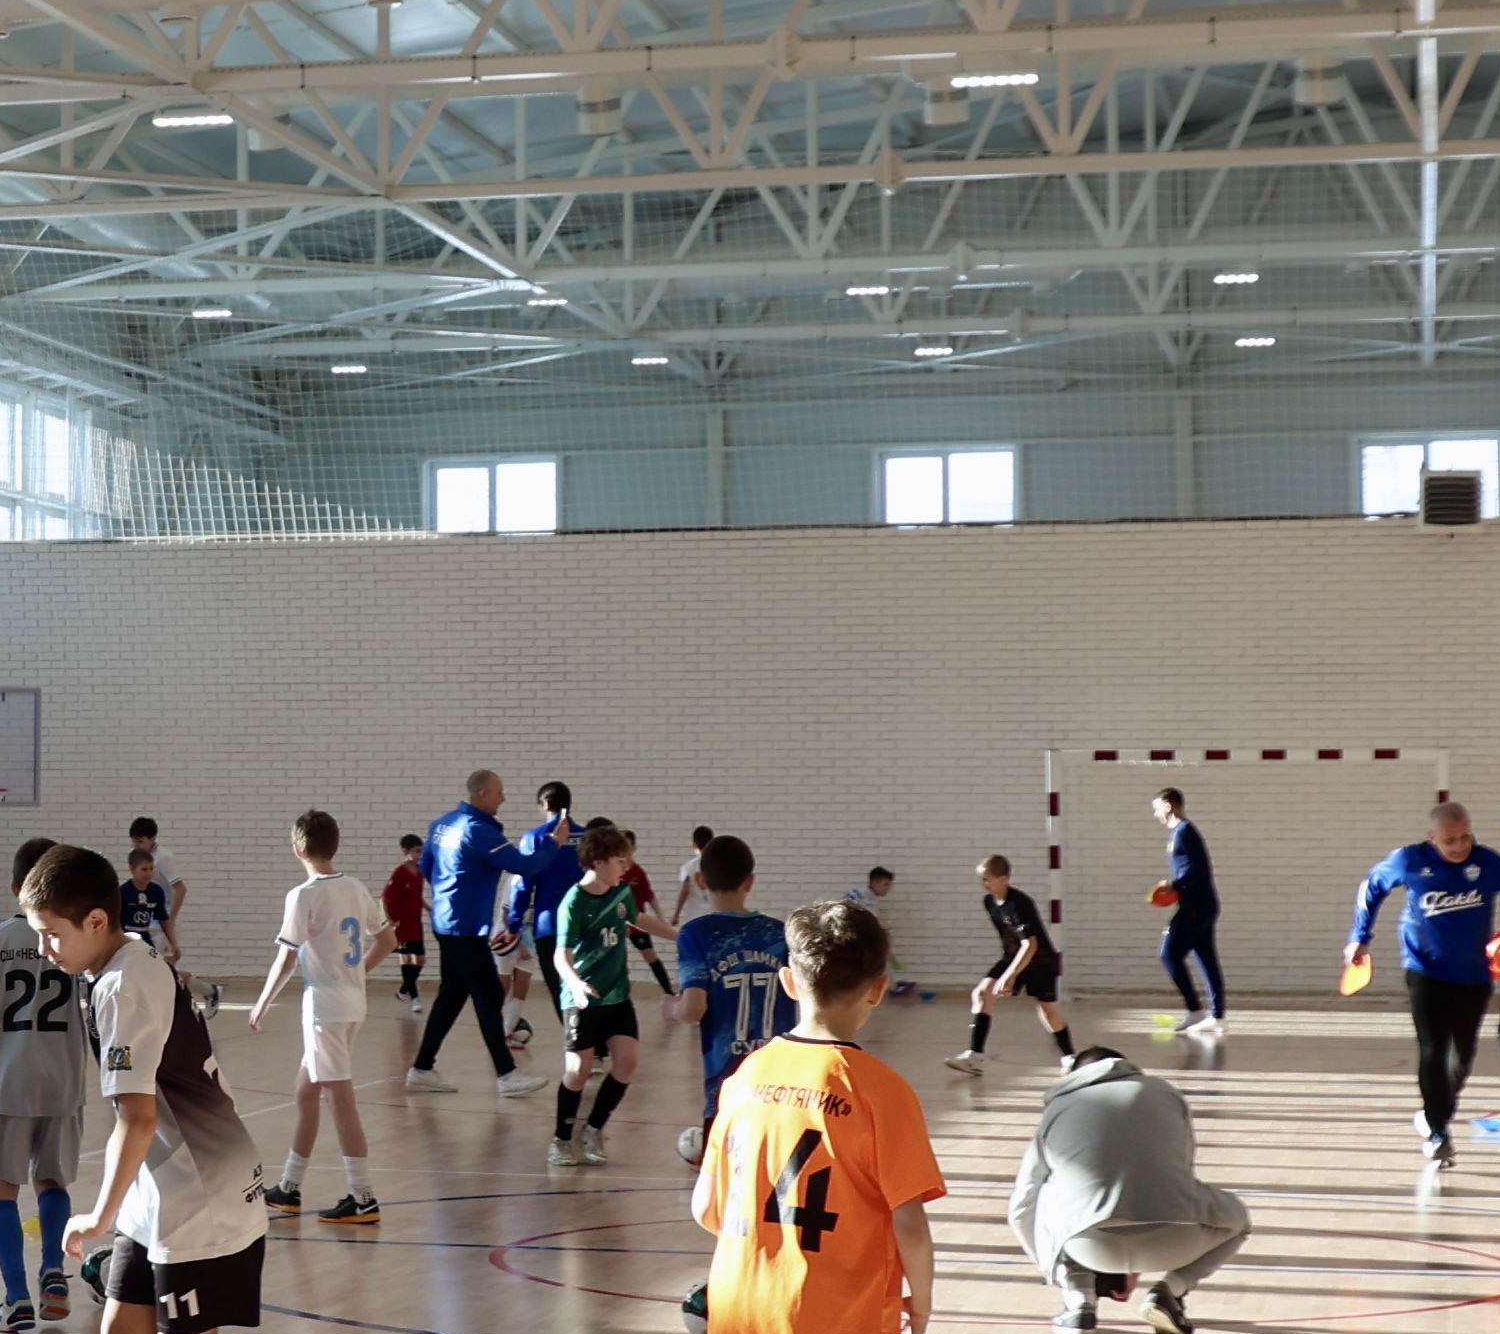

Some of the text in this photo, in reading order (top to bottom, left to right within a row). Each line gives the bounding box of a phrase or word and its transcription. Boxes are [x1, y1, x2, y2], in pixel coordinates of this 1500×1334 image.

[0, 949, 15, 962] СШ
[340, 916, 361, 968] 3
[600, 926, 619, 948] 16
[3, 969, 72, 1032] 22
[722, 972, 780, 1042] 77
[159, 1287, 201, 1320] 11
